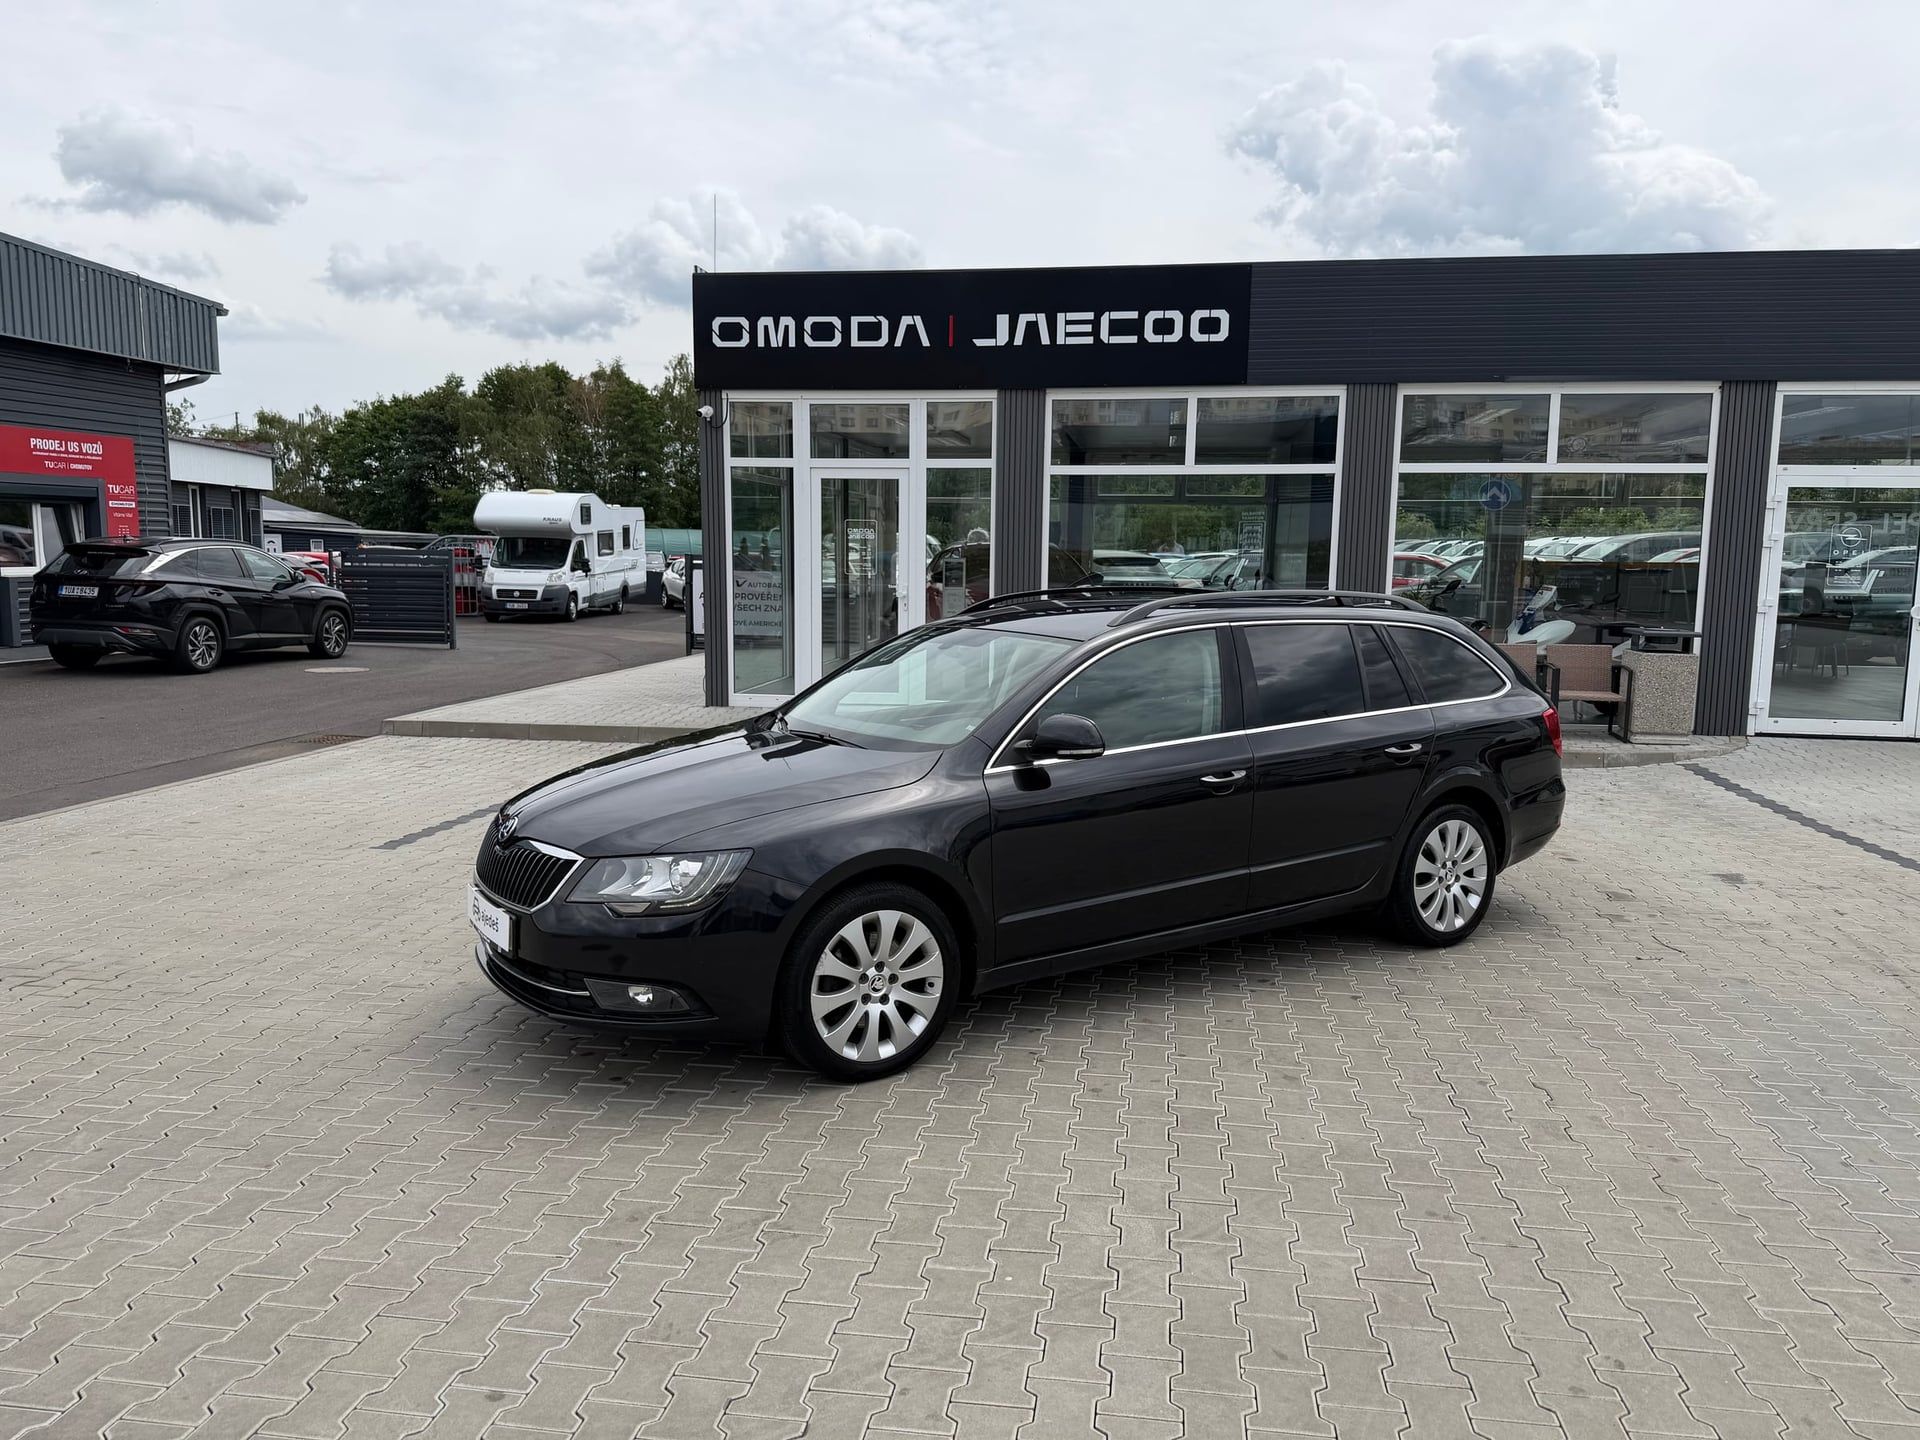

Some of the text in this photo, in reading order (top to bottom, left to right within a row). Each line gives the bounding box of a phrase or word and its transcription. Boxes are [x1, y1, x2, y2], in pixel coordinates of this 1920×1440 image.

[711, 309, 1230, 348] OMODA JAECOO
[30, 437, 103, 455] PRODEJ US VOZŮ
[44, 460, 66, 469] TUCAR
[107, 484, 135, 494] TUCAR
[734, 601, 762, 612] ŠECH
